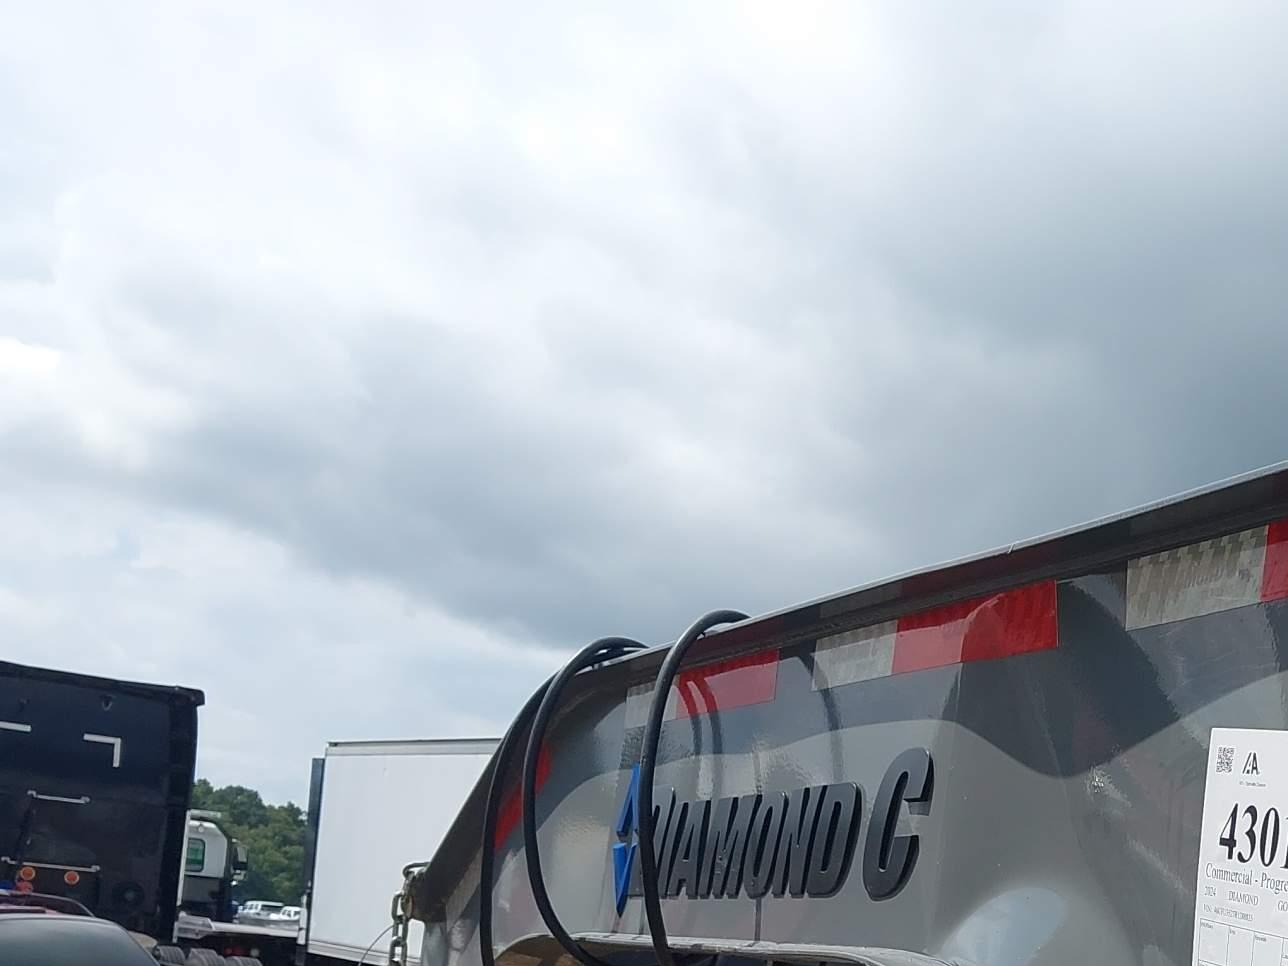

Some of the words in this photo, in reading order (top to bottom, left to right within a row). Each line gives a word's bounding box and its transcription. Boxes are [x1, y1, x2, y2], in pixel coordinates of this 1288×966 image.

[863, 746, 935, 902] C
[1205, 863, 1253, 886] Commercial
[1228, 890, 1259, 906] DIAMOND
